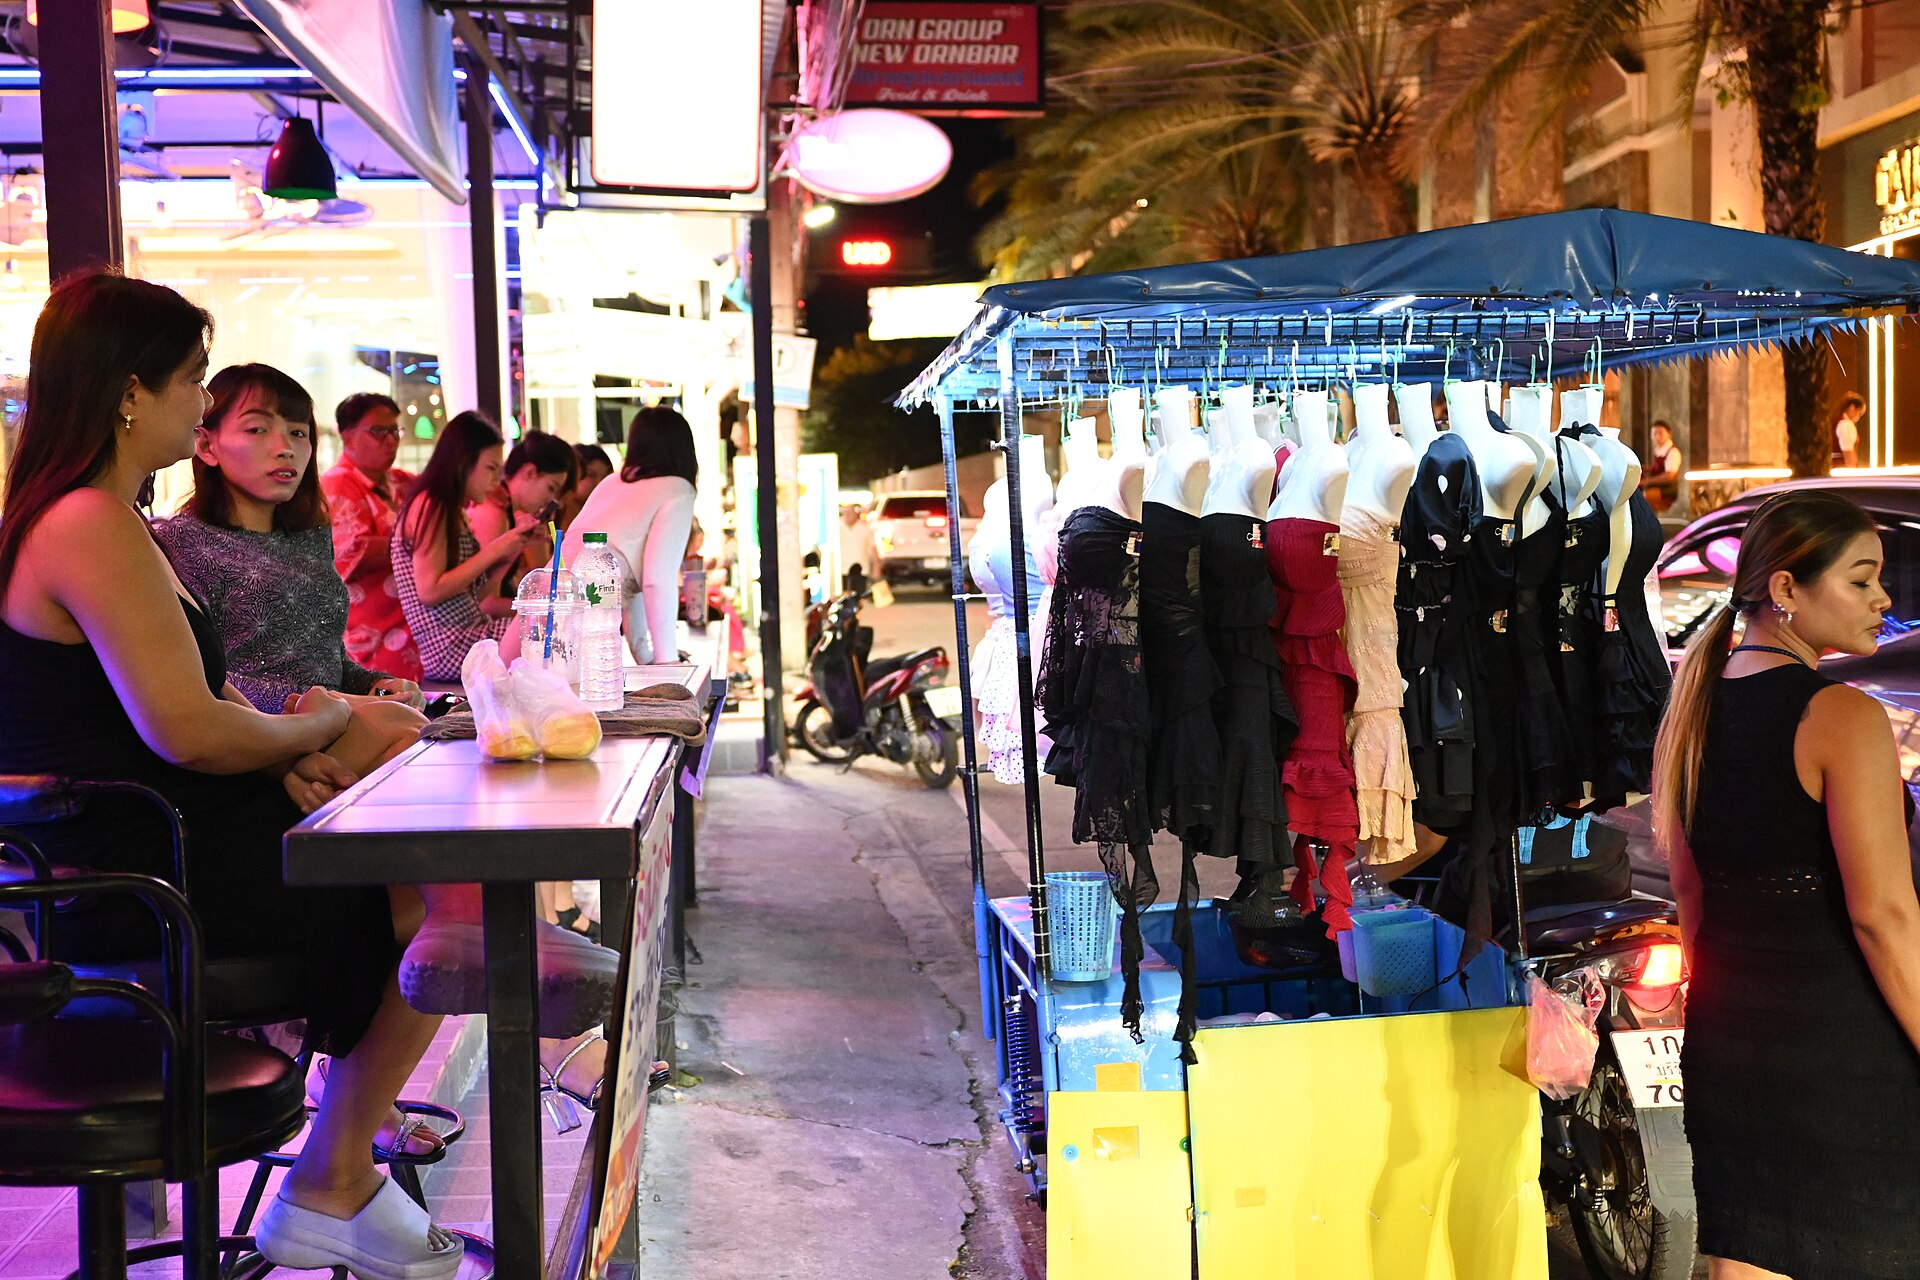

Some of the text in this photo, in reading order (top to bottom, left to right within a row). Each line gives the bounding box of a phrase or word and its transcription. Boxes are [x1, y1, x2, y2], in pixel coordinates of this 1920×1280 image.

[863, 18, 1004, 41] ORN GROUP
[852, 43, 1020, 64] NEW ORNBAR
